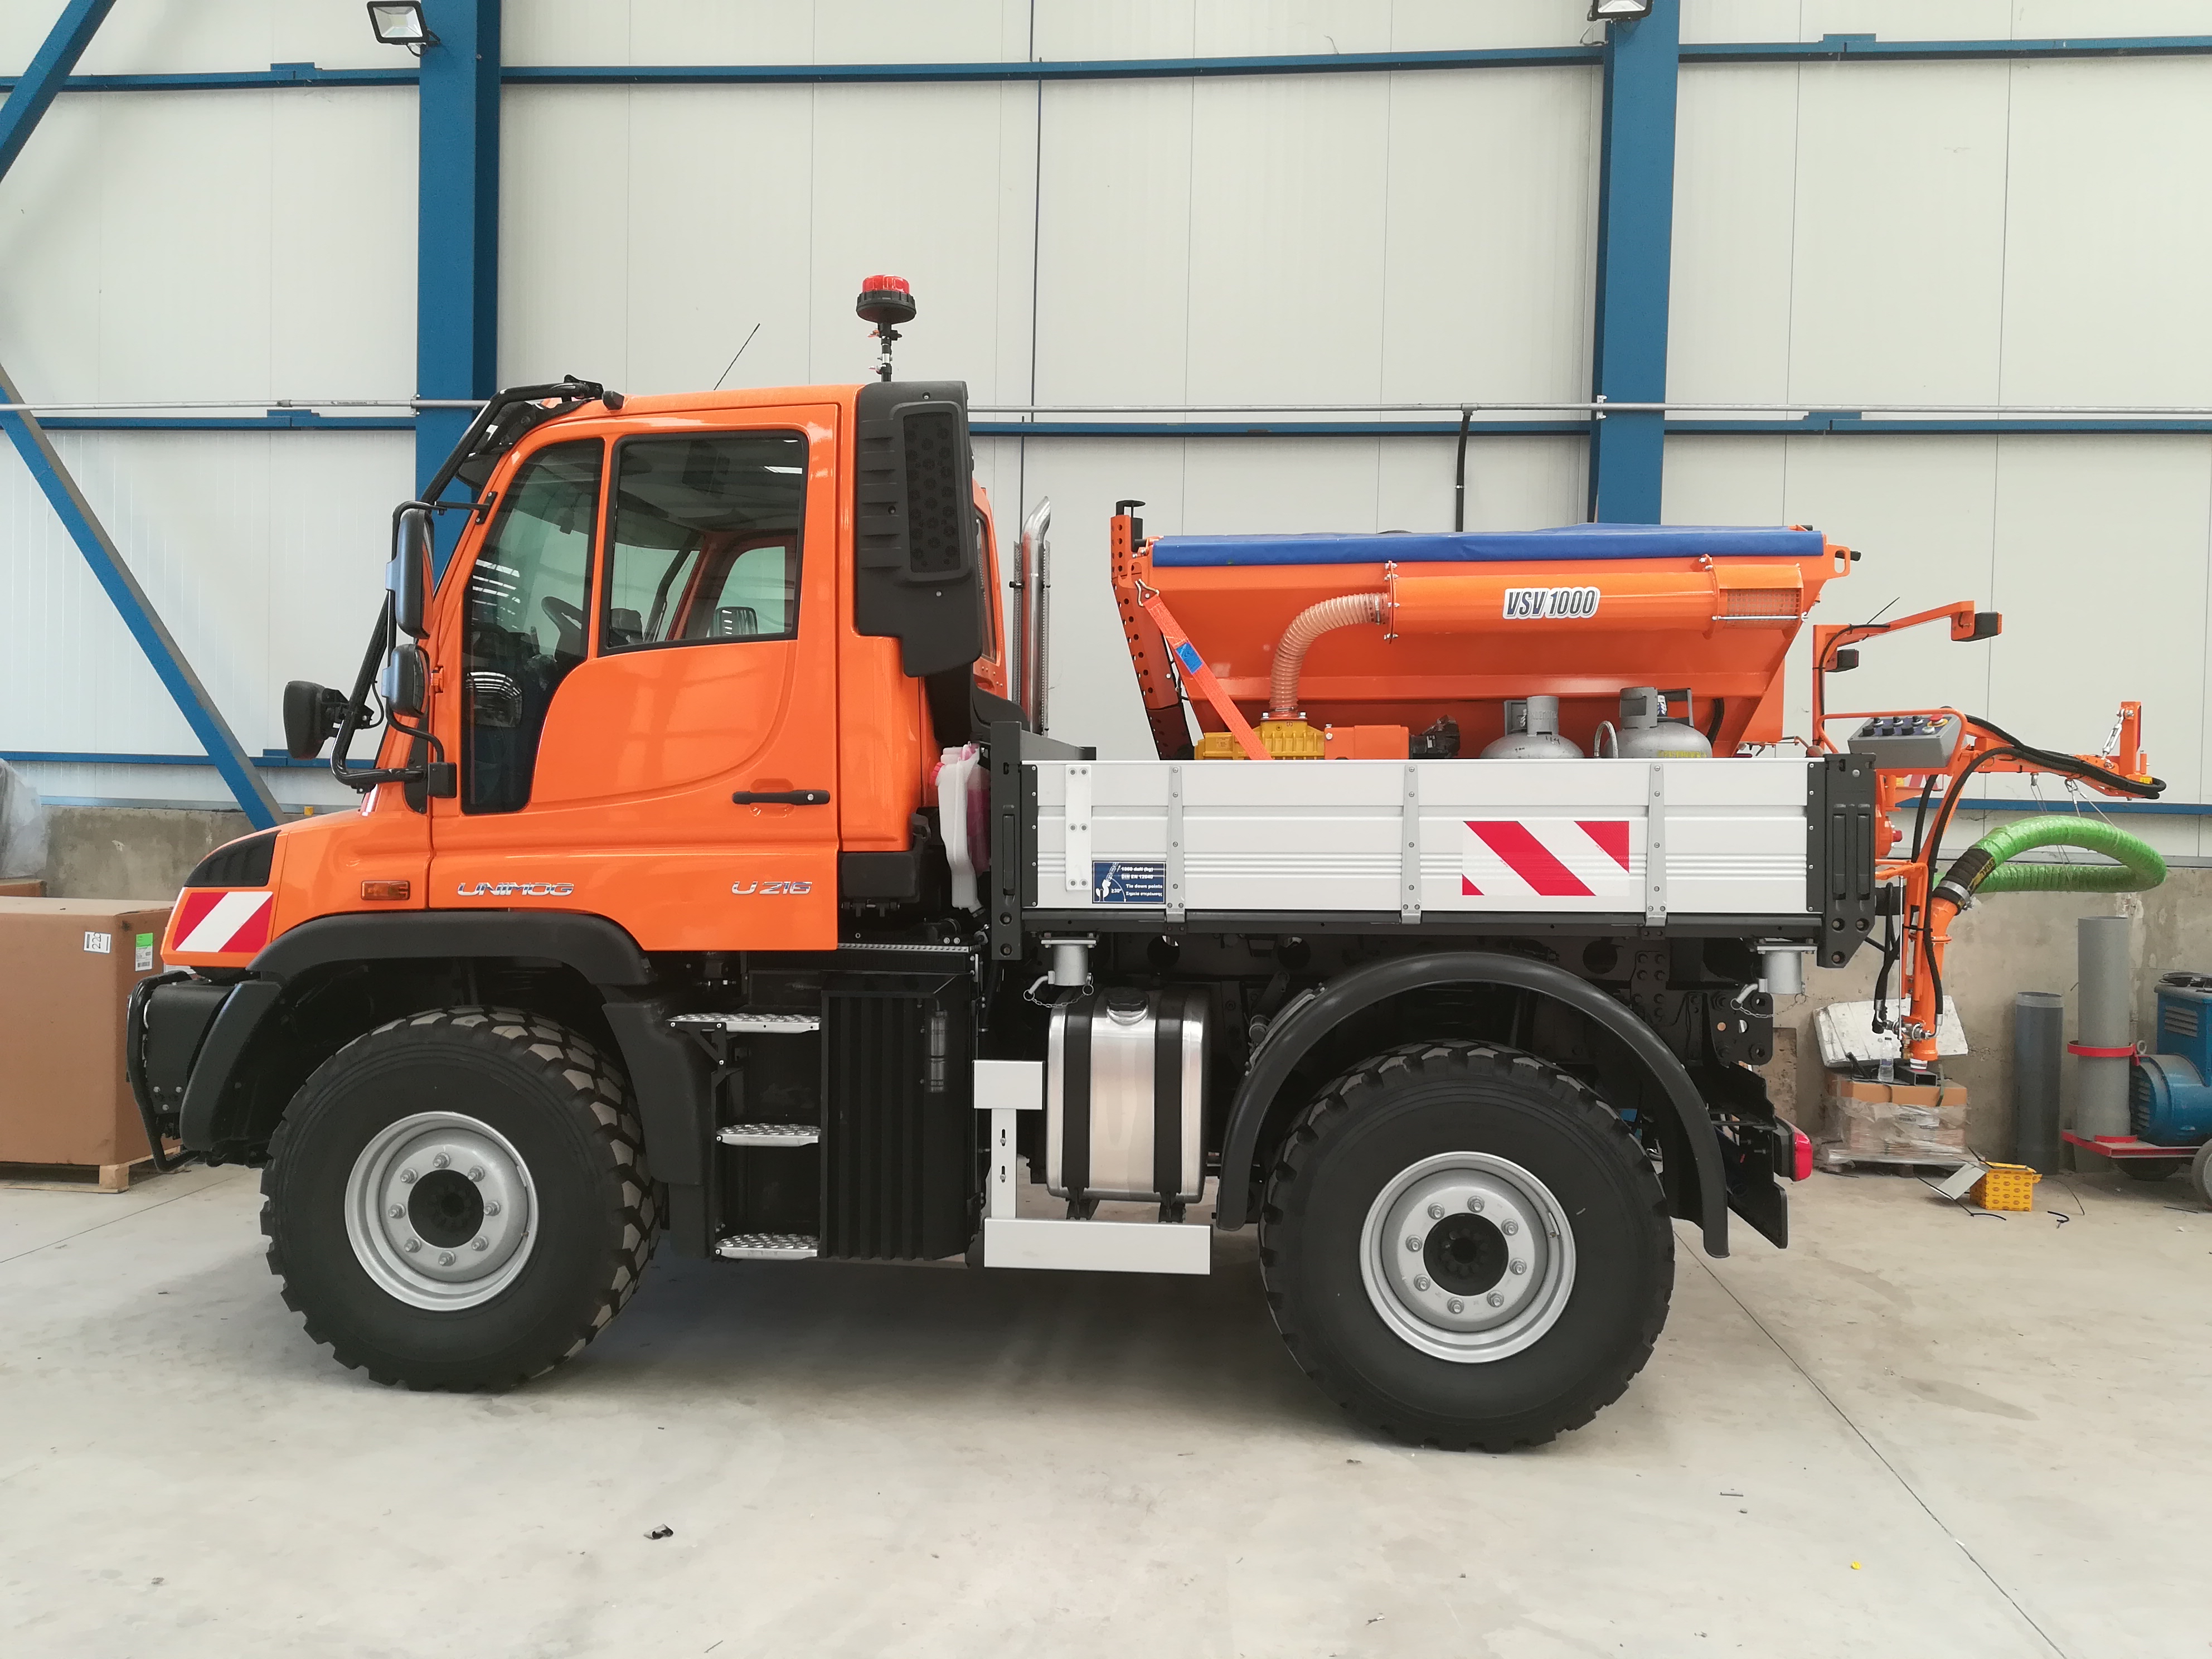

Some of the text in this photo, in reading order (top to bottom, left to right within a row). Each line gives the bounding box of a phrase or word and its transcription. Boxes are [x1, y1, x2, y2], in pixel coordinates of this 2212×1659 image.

[1506, 590, 1597, 616] VSV 1000
[457, 882, 575, 896] UNIMOG
[731, 881, 813, 894] U 216
